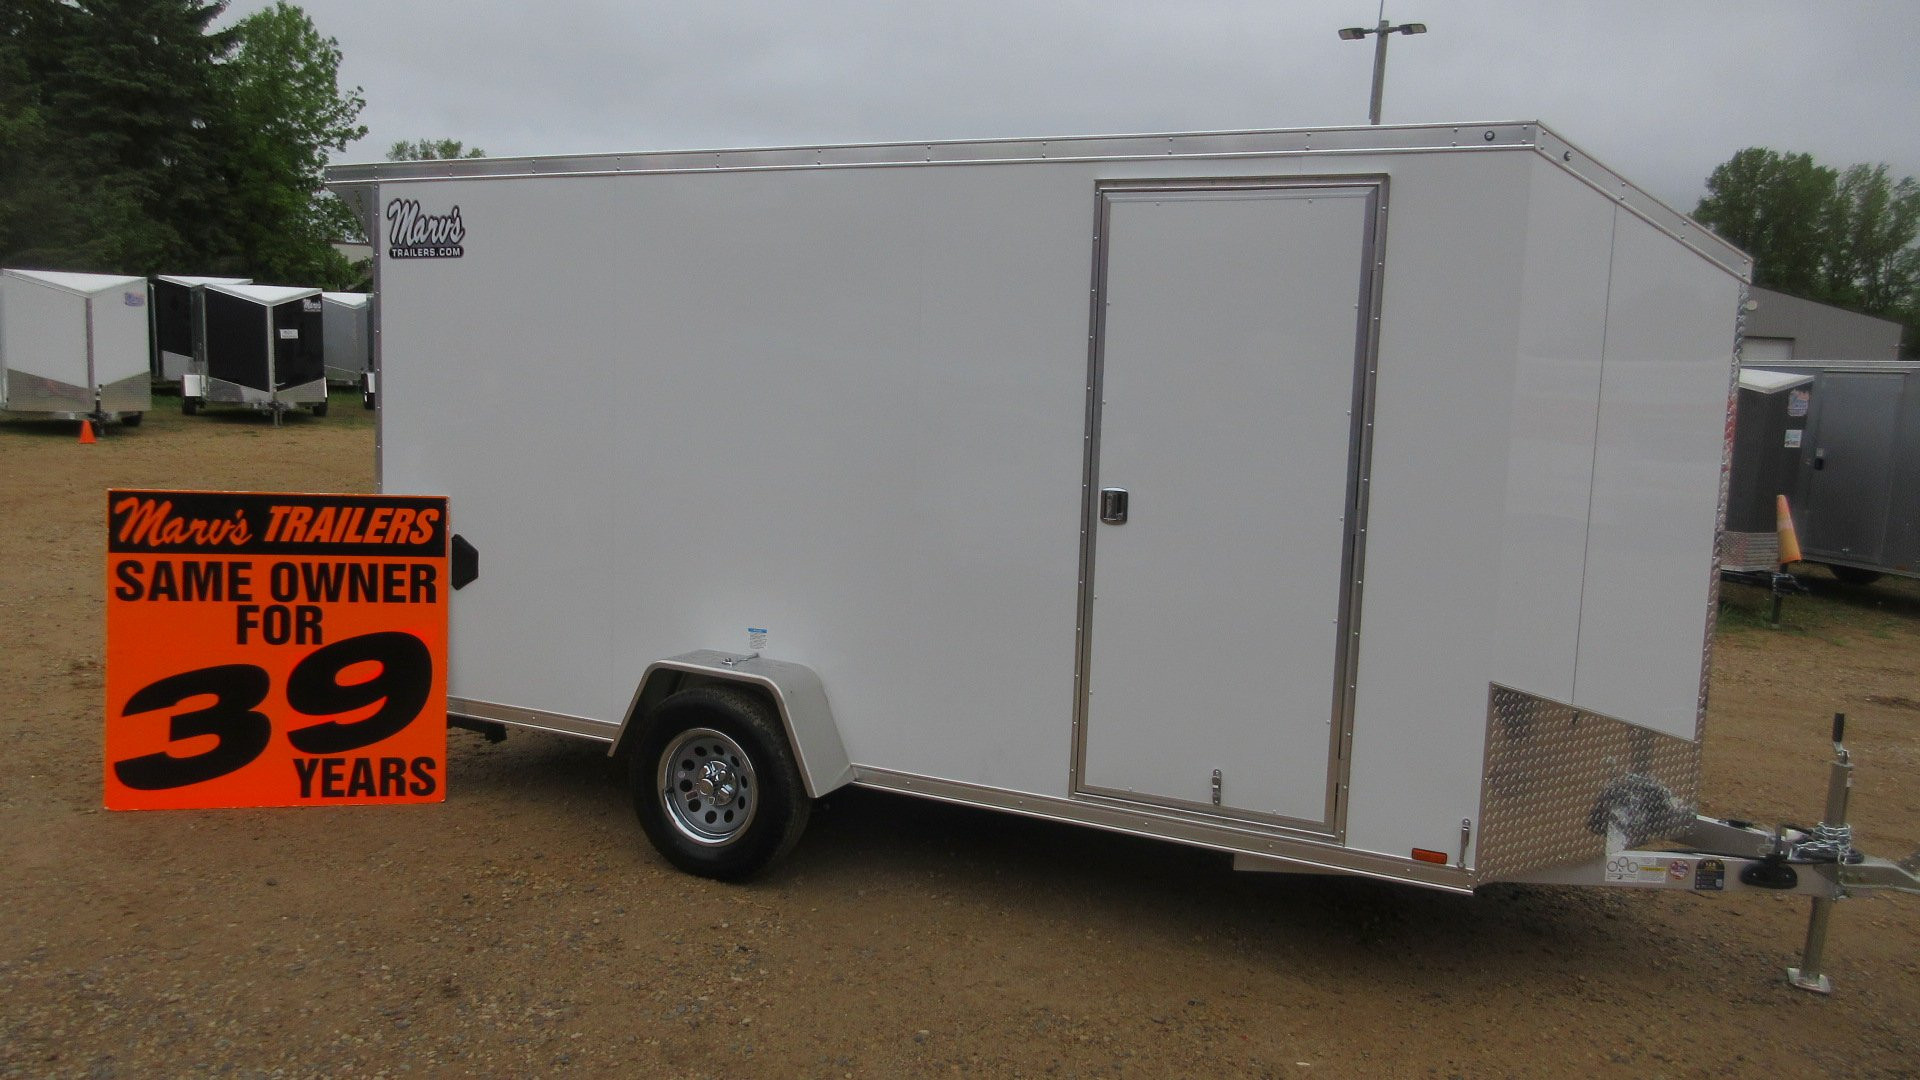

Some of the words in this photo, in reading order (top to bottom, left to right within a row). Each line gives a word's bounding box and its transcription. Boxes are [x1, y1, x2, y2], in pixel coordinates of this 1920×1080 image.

[386, 197, 466, 247] Marv's
[391, 247, 461, 257] TRAILERS.COM
[114, 497, 253, 547] Marv's
[263, 505, 440, 544] TRAILERS
[115, 559, 253, 602] SAME
[269, 562, 437, 603] OWNER
[236, 604, 324, 645] FOR
[114, 631, 433, 791] 39
[292, 756, 437, 798] YEARS
